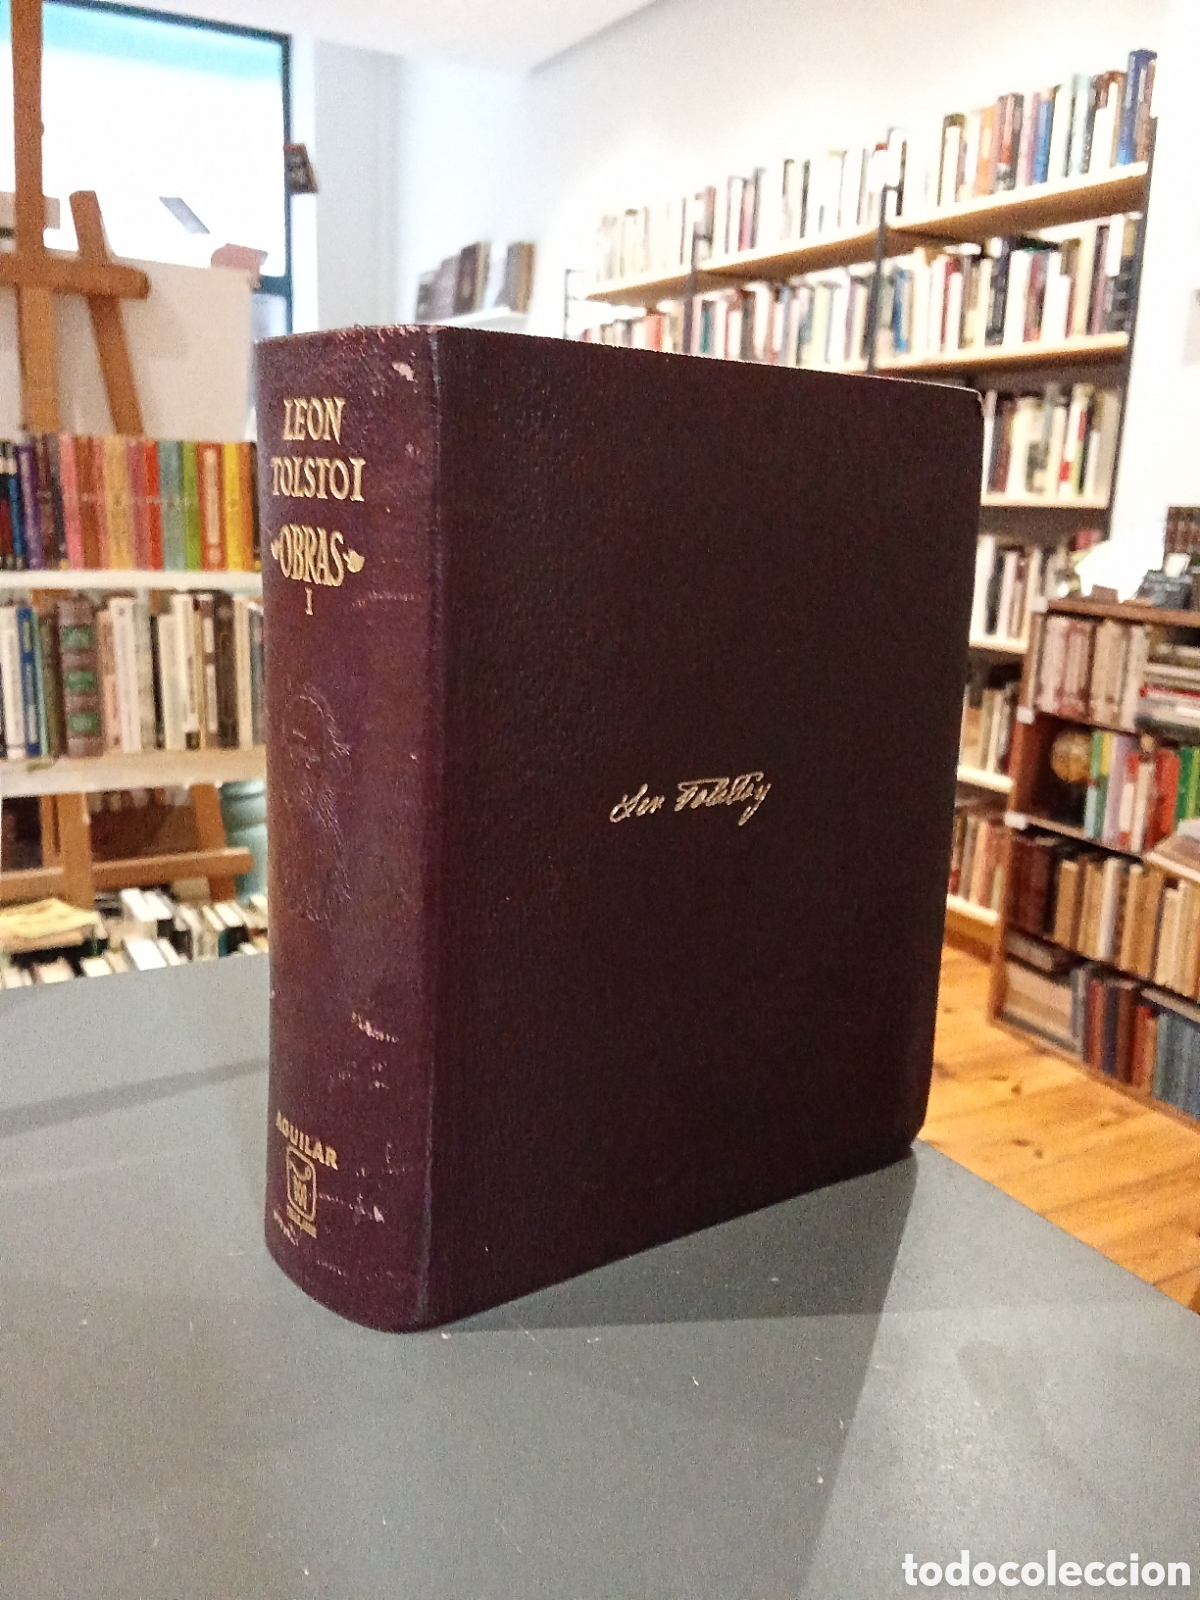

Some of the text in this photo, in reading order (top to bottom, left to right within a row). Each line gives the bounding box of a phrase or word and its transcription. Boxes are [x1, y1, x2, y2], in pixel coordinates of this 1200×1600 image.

[282, 396, 346, 445] LEON
[270, 456, 366, 502] TOLSTOI
[279, 523, 345, 587] OBRAS
[275, 1109, 339, 1171] AGUILAR
